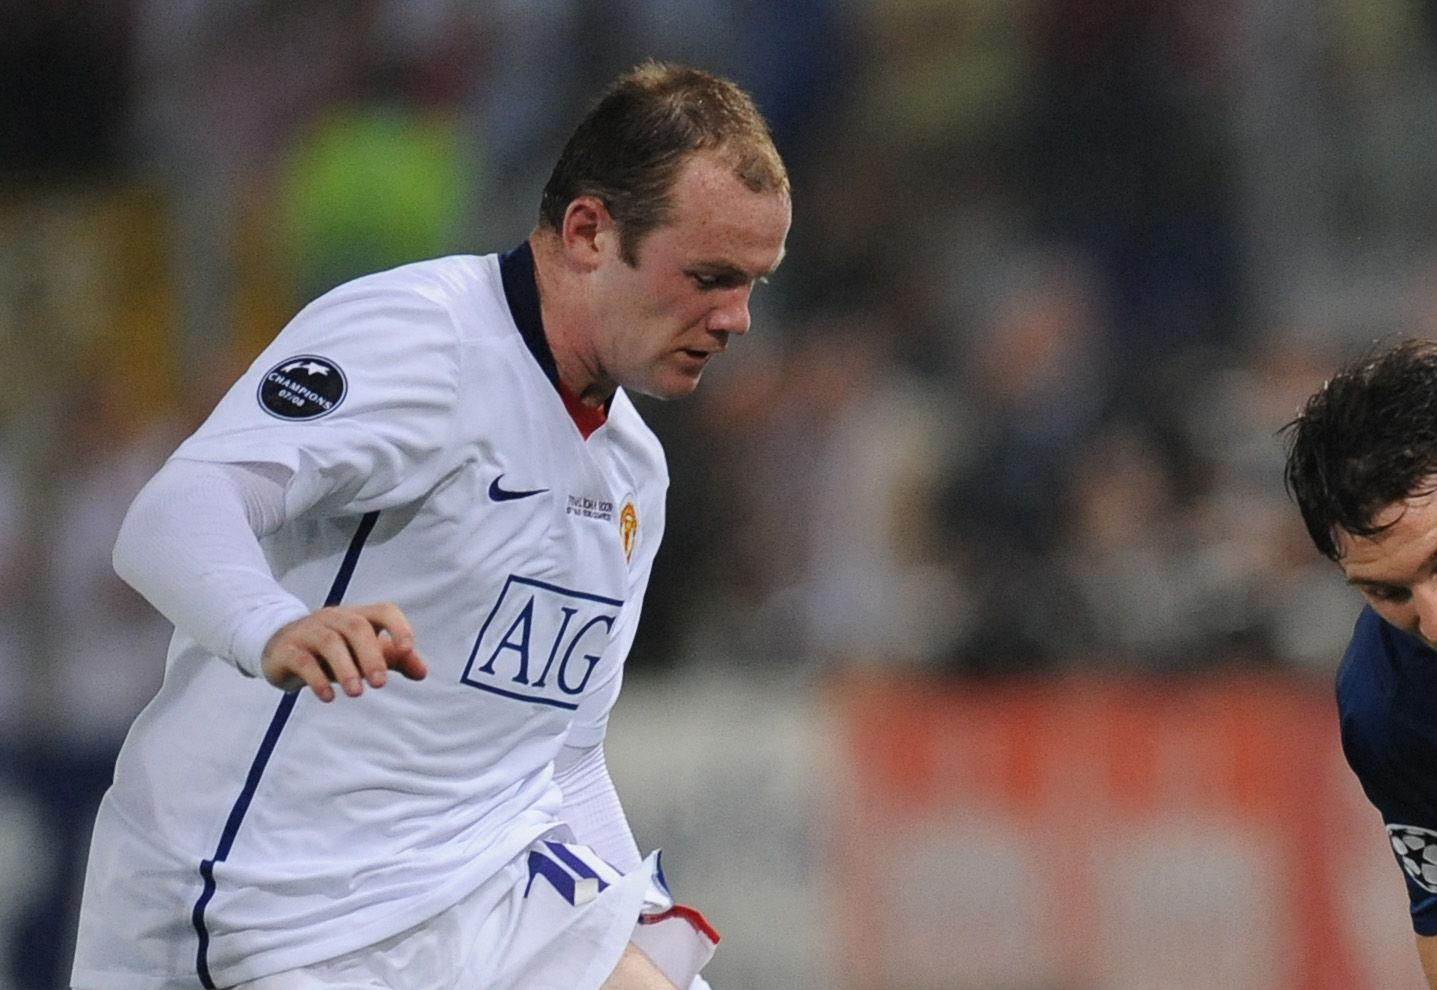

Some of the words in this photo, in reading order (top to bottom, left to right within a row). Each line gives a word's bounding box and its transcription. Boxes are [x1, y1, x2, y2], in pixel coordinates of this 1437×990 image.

[268, 372, 333, 410] CHAMPIONS
[278, 389, 306, 407] 07/08
[478, 595, 617, 695] AIG
